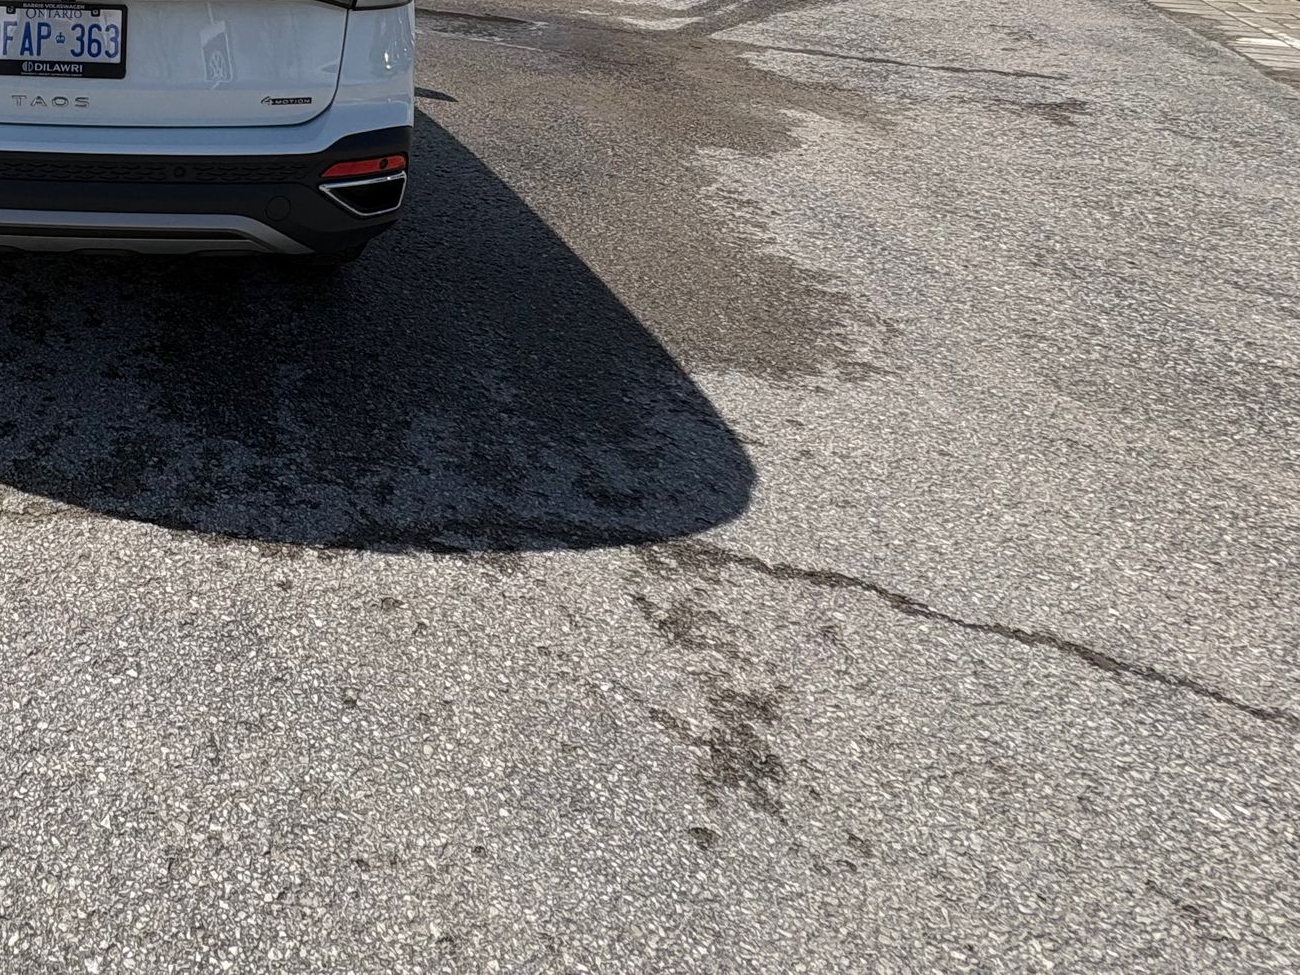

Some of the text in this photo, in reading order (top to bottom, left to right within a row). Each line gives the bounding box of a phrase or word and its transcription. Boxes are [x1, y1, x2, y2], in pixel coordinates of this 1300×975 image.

[70, 23, 120, 59] 363
[34, 62, 83, 73] DILAWRI
[11, 95, 90, 107] TAOS
